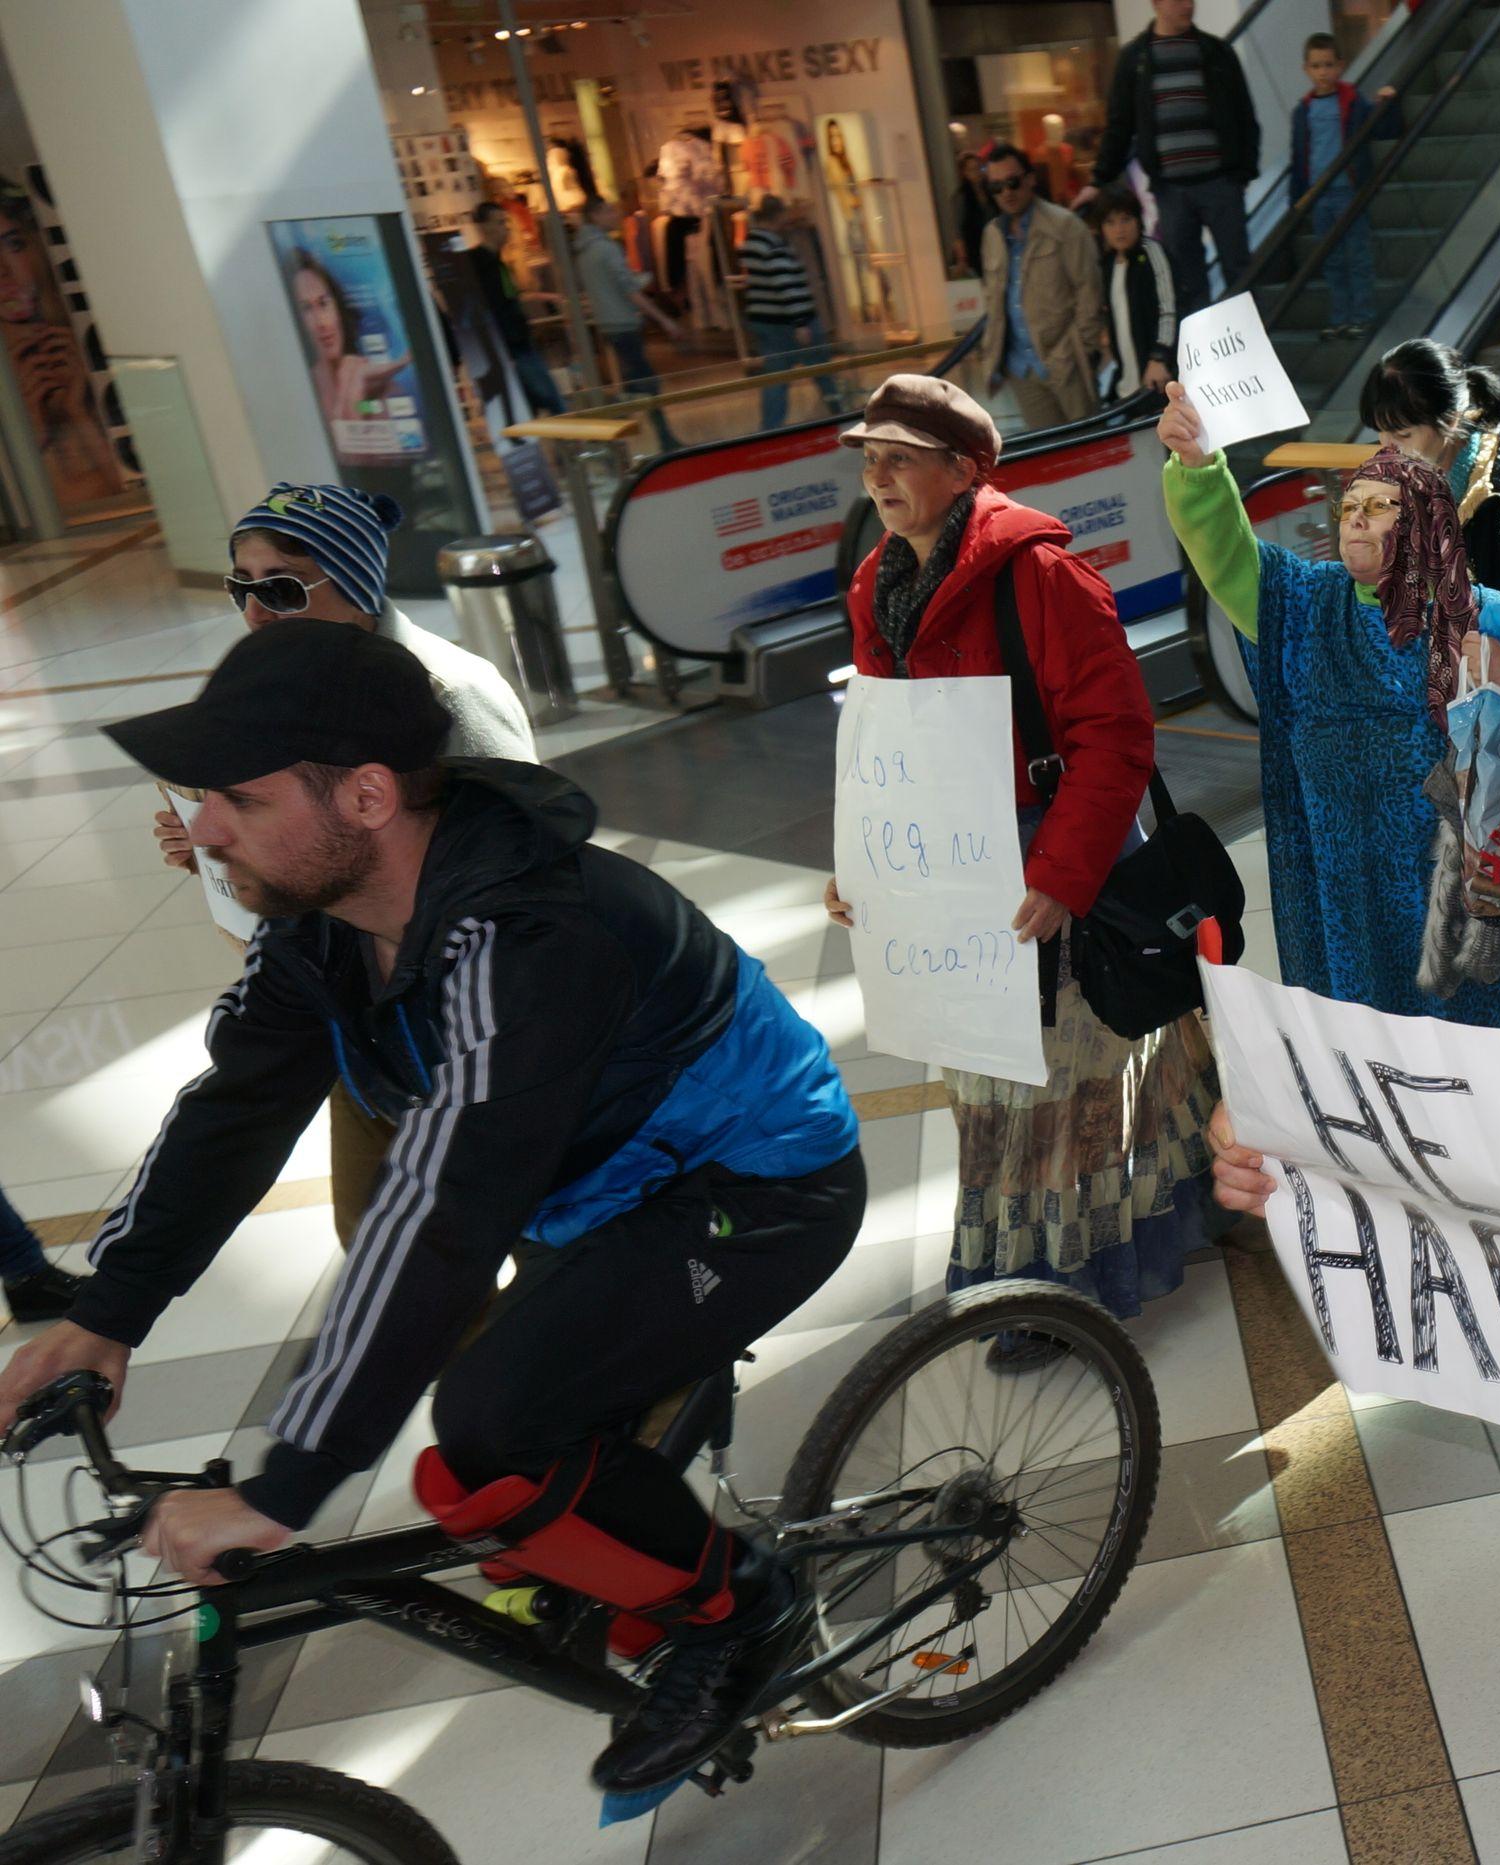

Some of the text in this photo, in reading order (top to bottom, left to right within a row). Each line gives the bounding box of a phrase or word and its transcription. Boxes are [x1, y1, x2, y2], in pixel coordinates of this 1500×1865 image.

[660, 38, 880, 91] WE MAKE SEXY
[1185, 326, 1247, 371] Je suis
[1198, 375, 1266, 408] Нягол
[768, 480, 839, 508] ORIGINAL
[771, 495, 838, 522] MARINES
[1060, 493, 1127, 525] ORIGINAL
[952, 832, 992, 867] ли
[687, 1258, 704, 1305] adidas
